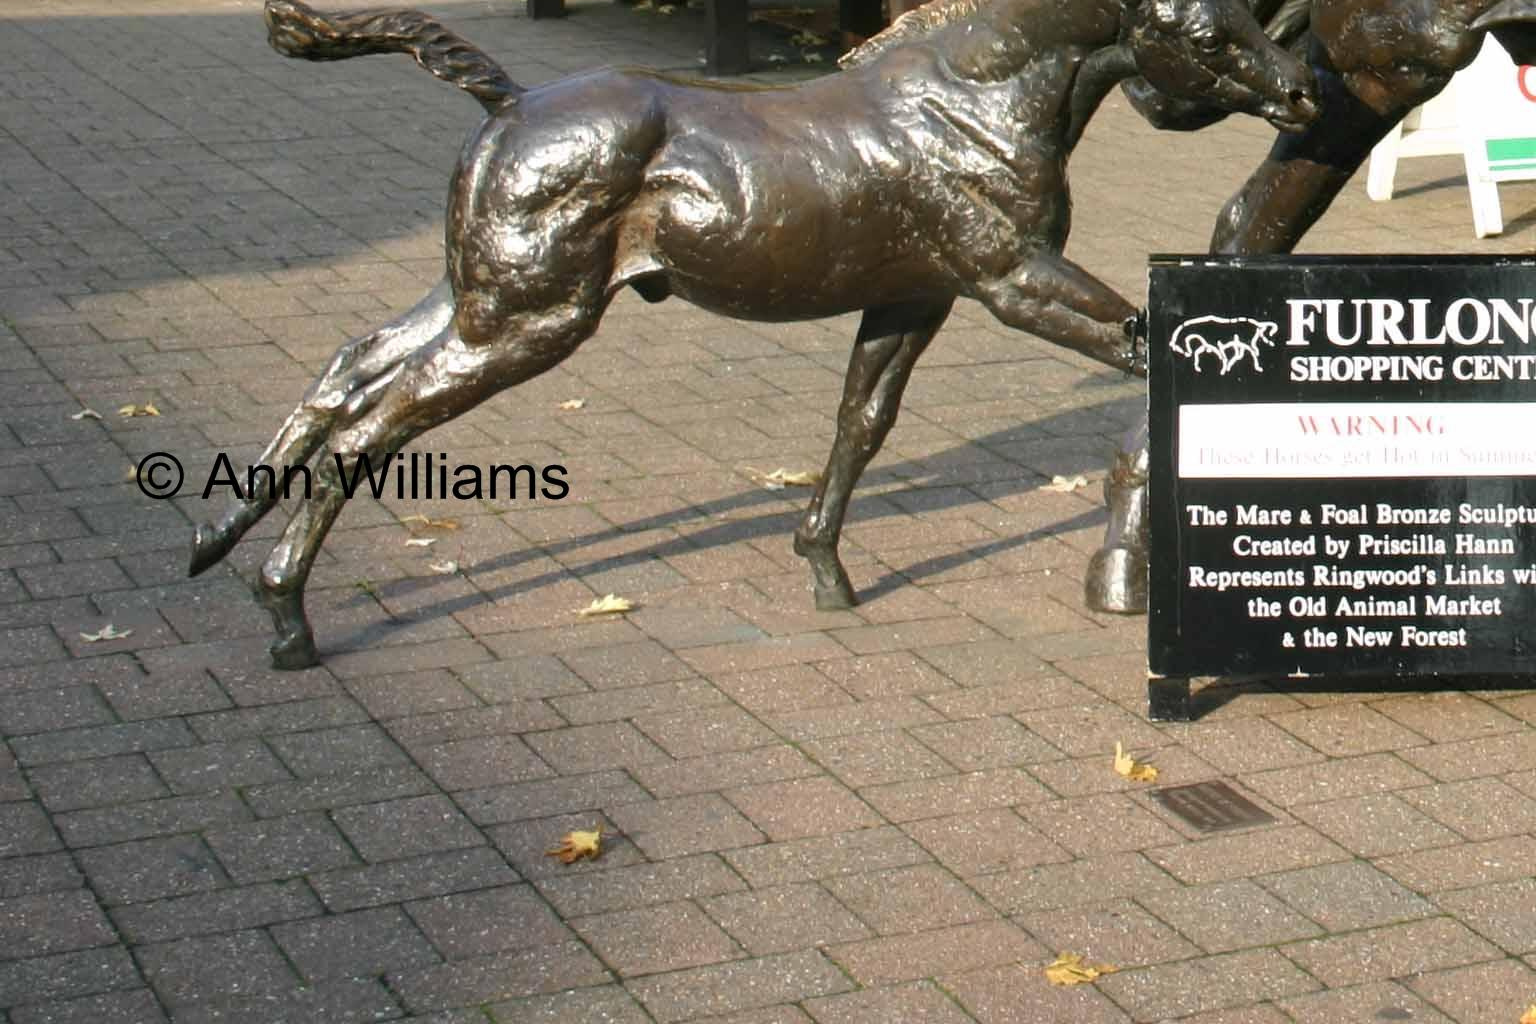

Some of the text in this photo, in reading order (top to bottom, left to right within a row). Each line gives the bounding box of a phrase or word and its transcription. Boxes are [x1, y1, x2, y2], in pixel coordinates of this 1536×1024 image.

[1290, 355, 1444, 382] SHOPPING
[1297, 414, 1446, 437] WARNING
[1199, 447, 1256, 466] These
[1265, 447, 1334, 466] Horses
[1342, 449, 1371, 469] get
[1383, 447, 1419, 465] Hot
[1431, 448, 1450, 465] in
[1185, 504, 1228, 526] The
[1235, 504, 1292, 526] Mare
[1299, 509, 1313, 525] &
[1320, 503, 1369, 525] Foal
[1376, 503, 1452, 525] Bronze
[1232, 533, 1515, 560] Created by Priscilla Hann
[1188, 565, 1305, 592] Represents
[1312, 564, 1438, 590] Ringwood's
[1444, 563, 1506, 586] Links
[1247, 594, 1503, 618] the Old Animal Market
[1282, 625, 1467, 649] & the New Forest
